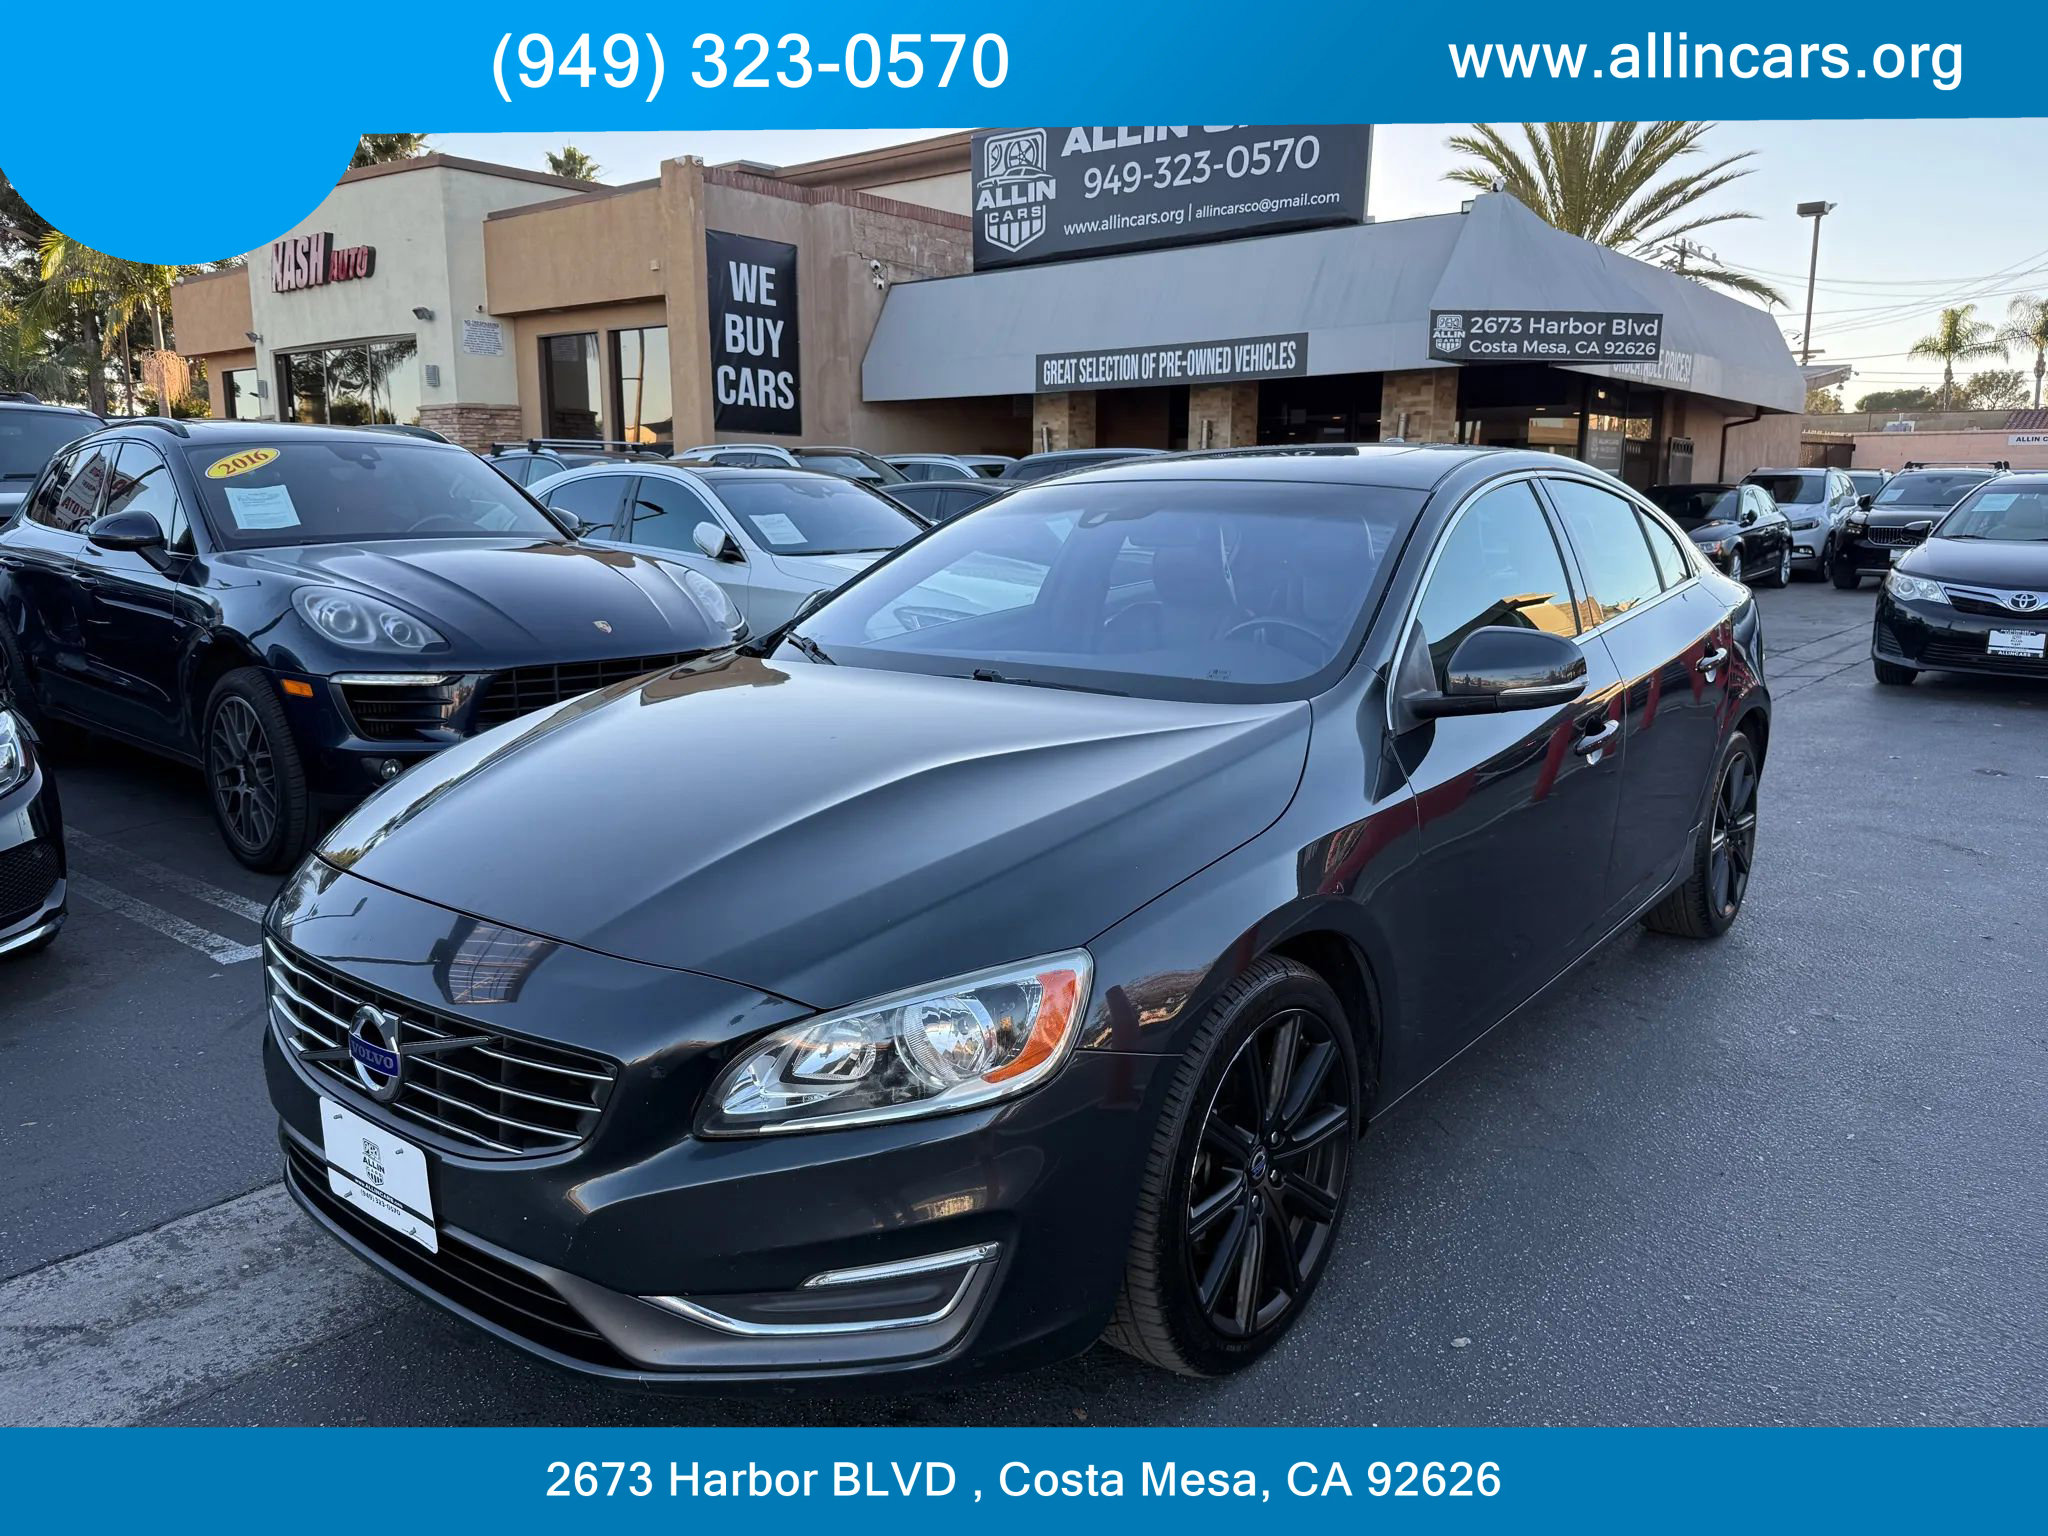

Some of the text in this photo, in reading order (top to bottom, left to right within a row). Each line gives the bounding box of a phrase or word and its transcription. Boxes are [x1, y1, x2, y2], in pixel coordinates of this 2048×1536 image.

[1084, 135, 1320, 199] 949-323-0570
[976, 179, 1056, 211] ALLIN
[1063, 191, 1340, 236] www.allincars.org allincarsco@gmail.com
[989, 206, 1041, 223] CARS
[272, 232, 369, 293] NASH AUTO
[729, 261, 777, 307] WE
[725, 313, 784, 358] BUY
[1470, 317, 1659, 336] 2673 Harbor Blvd
[1043, 340, 1297, 386] GREAT SELECTION OF PRE-OWNED VEHICLES
[1469, 340, 1656, 356] Costa Mesa, CA 92626
[717, 365, 795, 409] CARS
[218, 450, 269, 474] 2016
[351, 1041, 394, 1069] VOLVO
[362, 1156, 385, 1174] ALLIN
